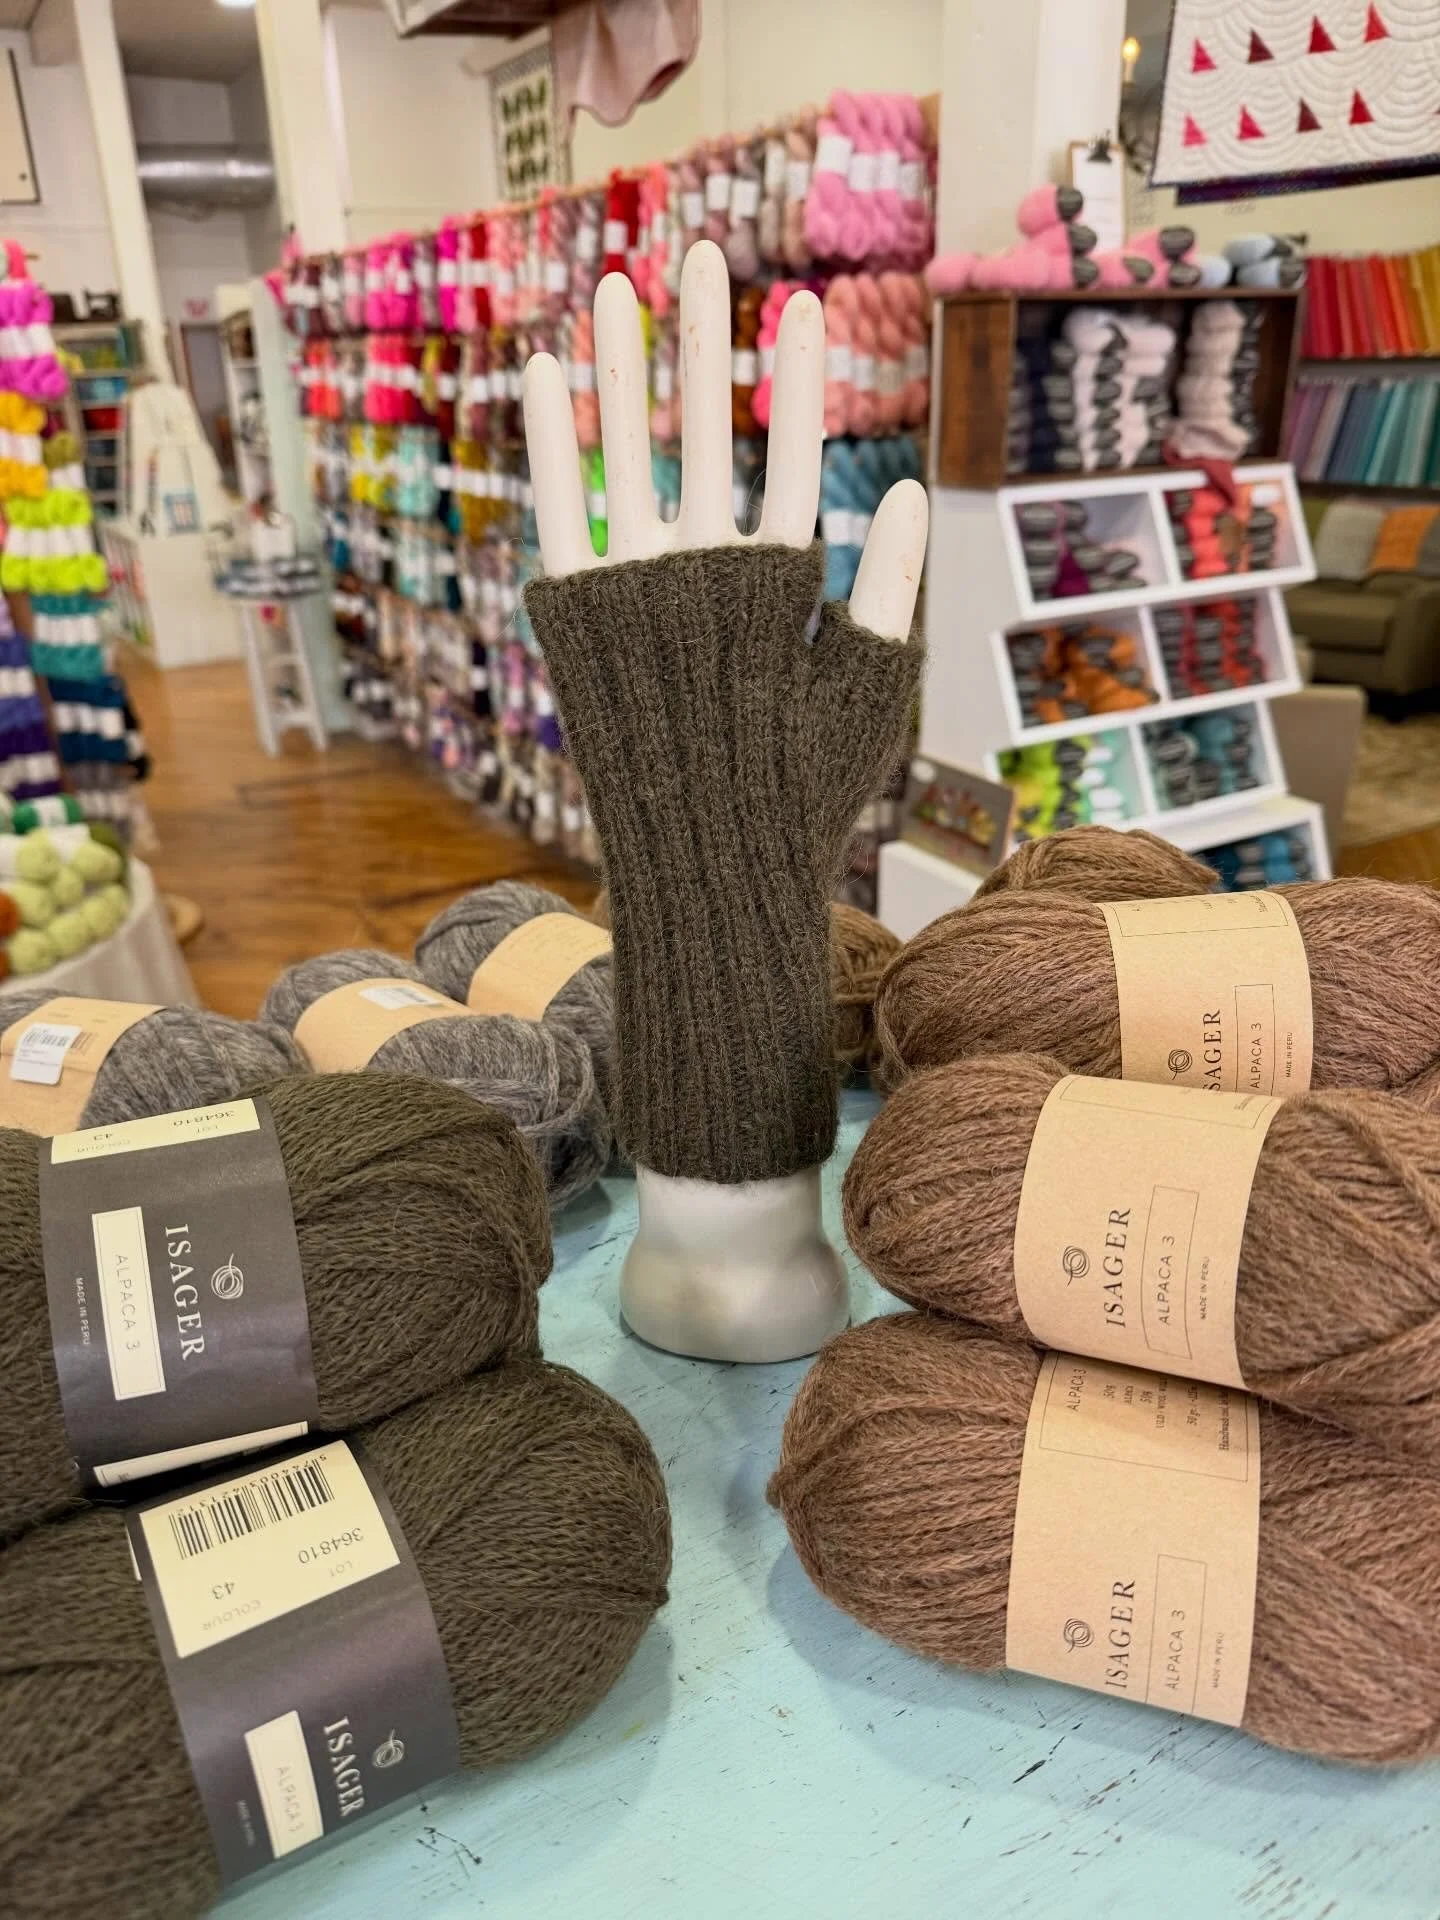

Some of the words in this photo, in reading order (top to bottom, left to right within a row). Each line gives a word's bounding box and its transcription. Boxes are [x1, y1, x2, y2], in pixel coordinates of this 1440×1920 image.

[1251, 1022, 1262, 1031] 3
[1203, 1009, 1222, 1091] SAGER
[1250, 1037, 1262, 1089] ALPACA
[1161, 1235, 1175, 1246] 3
[1102, 1208, 1131, 1328] ISAGER
[1201, 1256, 1210, 1280] PERU
[75, 1277, 86, 1305] MADE
[115, 1254, 137, 1331] ALPACA
[126, 1340, 140, 1351] 3
[165, 1223, 206, 1361] ISAGER
[1157, 1255, 1173, 1325] ALPACA
[79, 1306, 88, 1318] IN
[80, 1319, 90, 1345] PERU
[1066, 1376, 1085, 1412] ALPACA
[298, 1527, 364, 1564] 364810
[329, 1560, 354, 1577] LOT
[211, 1580, 235, 1600] 43
[201, 1598, 262, 1631] COLOUR
[1171, 1609, 1186, 1621] 3
[1105, 1580, 1136, 1688] ISAGER
[1165, 1630, 1184, 1690] ALPACA
[323, 1716, 365, 1817] ISAGER
[277, 1766, 300, 1820] ALPACA
